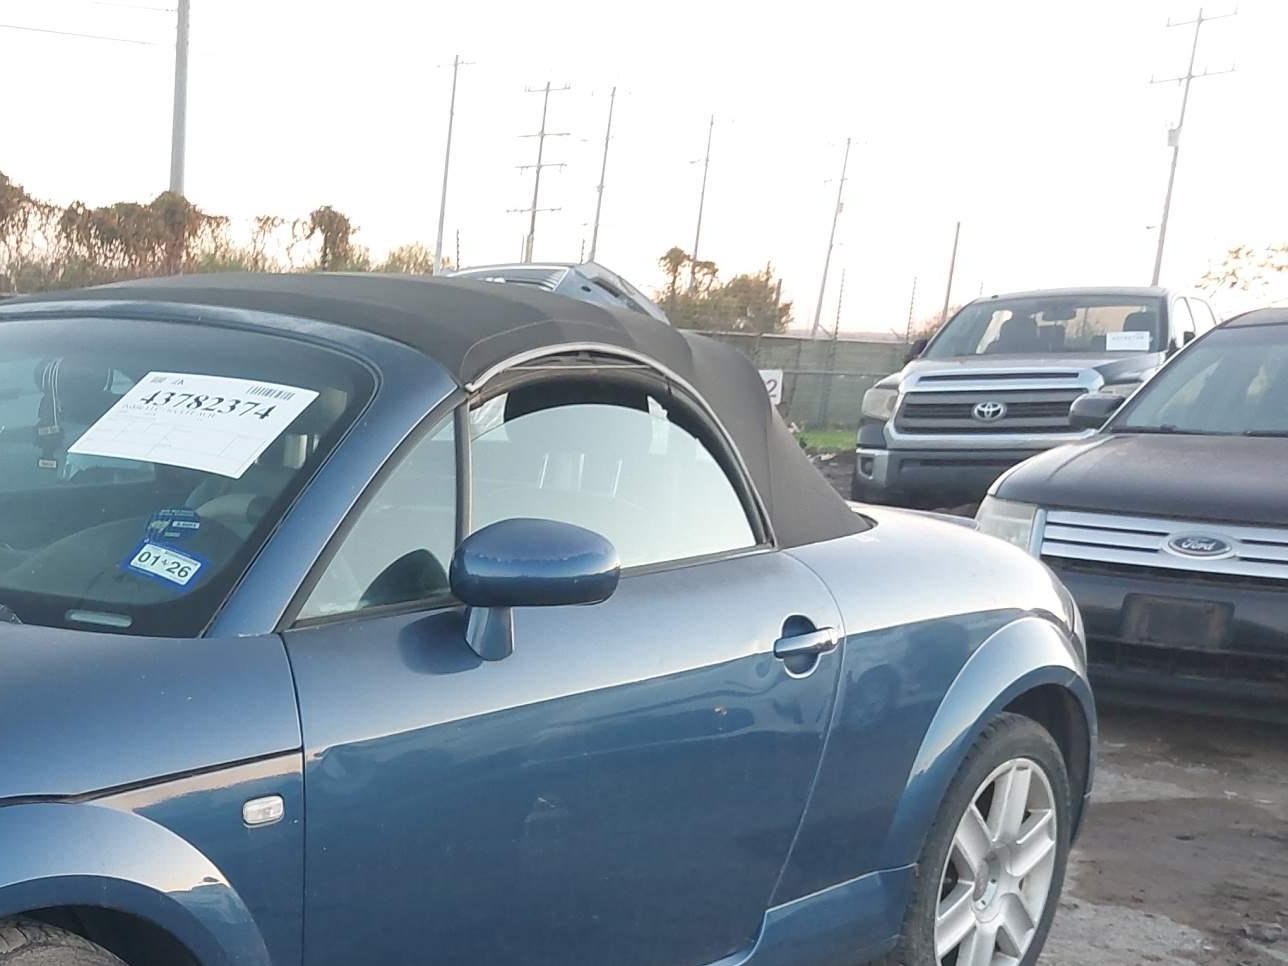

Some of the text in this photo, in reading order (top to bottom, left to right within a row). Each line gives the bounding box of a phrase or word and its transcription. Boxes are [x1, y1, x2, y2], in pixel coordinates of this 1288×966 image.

[140, 390, 278, 419] 43782374
[1181, 538, 1217, 551] Ford
[137, 551, 192, 578] 01 26
